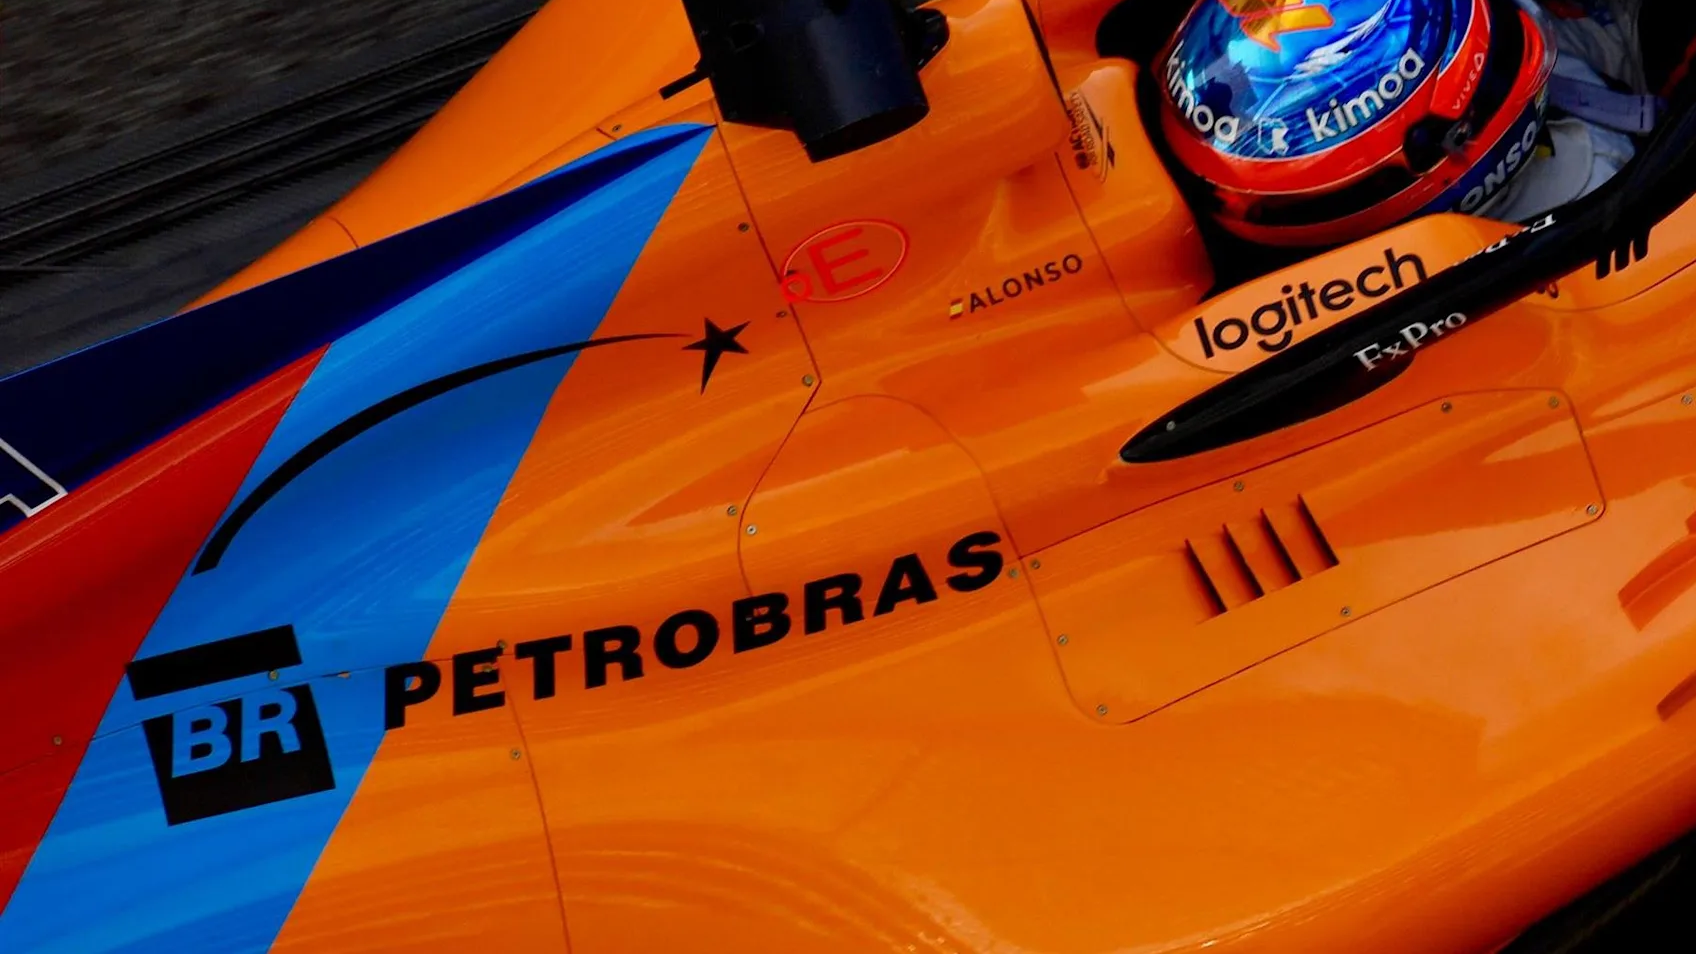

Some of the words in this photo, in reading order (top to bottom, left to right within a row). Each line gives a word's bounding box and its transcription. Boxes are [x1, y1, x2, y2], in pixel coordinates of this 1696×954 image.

[1166, 39, 1240, 143] kimoa
[1305, 47, 1426, 143] kimoa
[1459, 120, 1537, 212] ONSO
[807, 227, 884, 295] E
[970, 254, 1083, 313] ALONSO
[1195, 248, 1428, 359] logitech
[1353, 311, 1467, 372] FxPro
[384, 530, 1004, 730] PETROBRAS
[170, 688, 301, 779] BR
